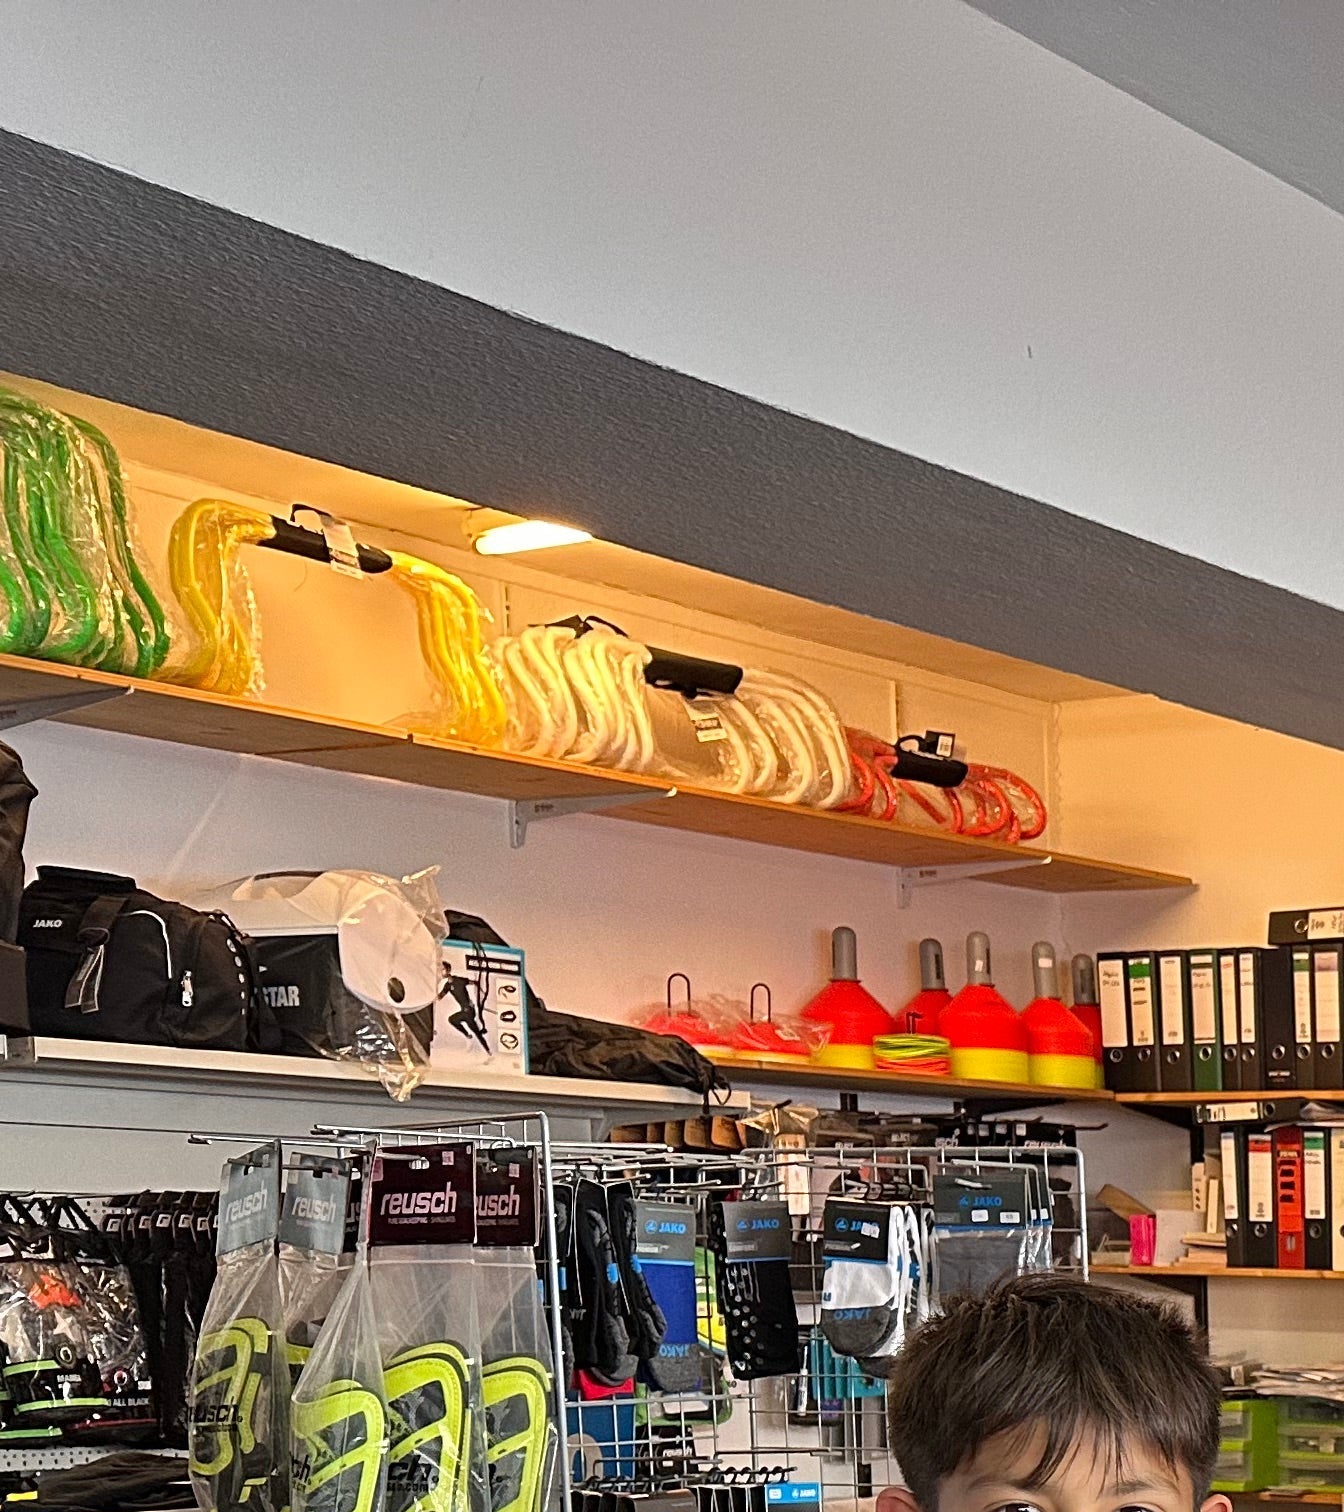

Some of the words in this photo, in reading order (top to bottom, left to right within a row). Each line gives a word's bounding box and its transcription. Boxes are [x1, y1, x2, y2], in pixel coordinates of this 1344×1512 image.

[33, 919, 63, 929] JAKO
[251, 985, 300, 1007] STAR
[224, 1180, 267, 1223] reusch
[380, 1182, 457, 1214] reusch
[475, 1185, 520, 1217] usch
[971, 1196, 1002, 1207] JAKO
[291, 1195, 336, 1224] reusch
[658, 1222, 687, 1234] JAKO
[751, 1218, 780, 1230] JAKO
[850, 1219, 880, 1232] JA
